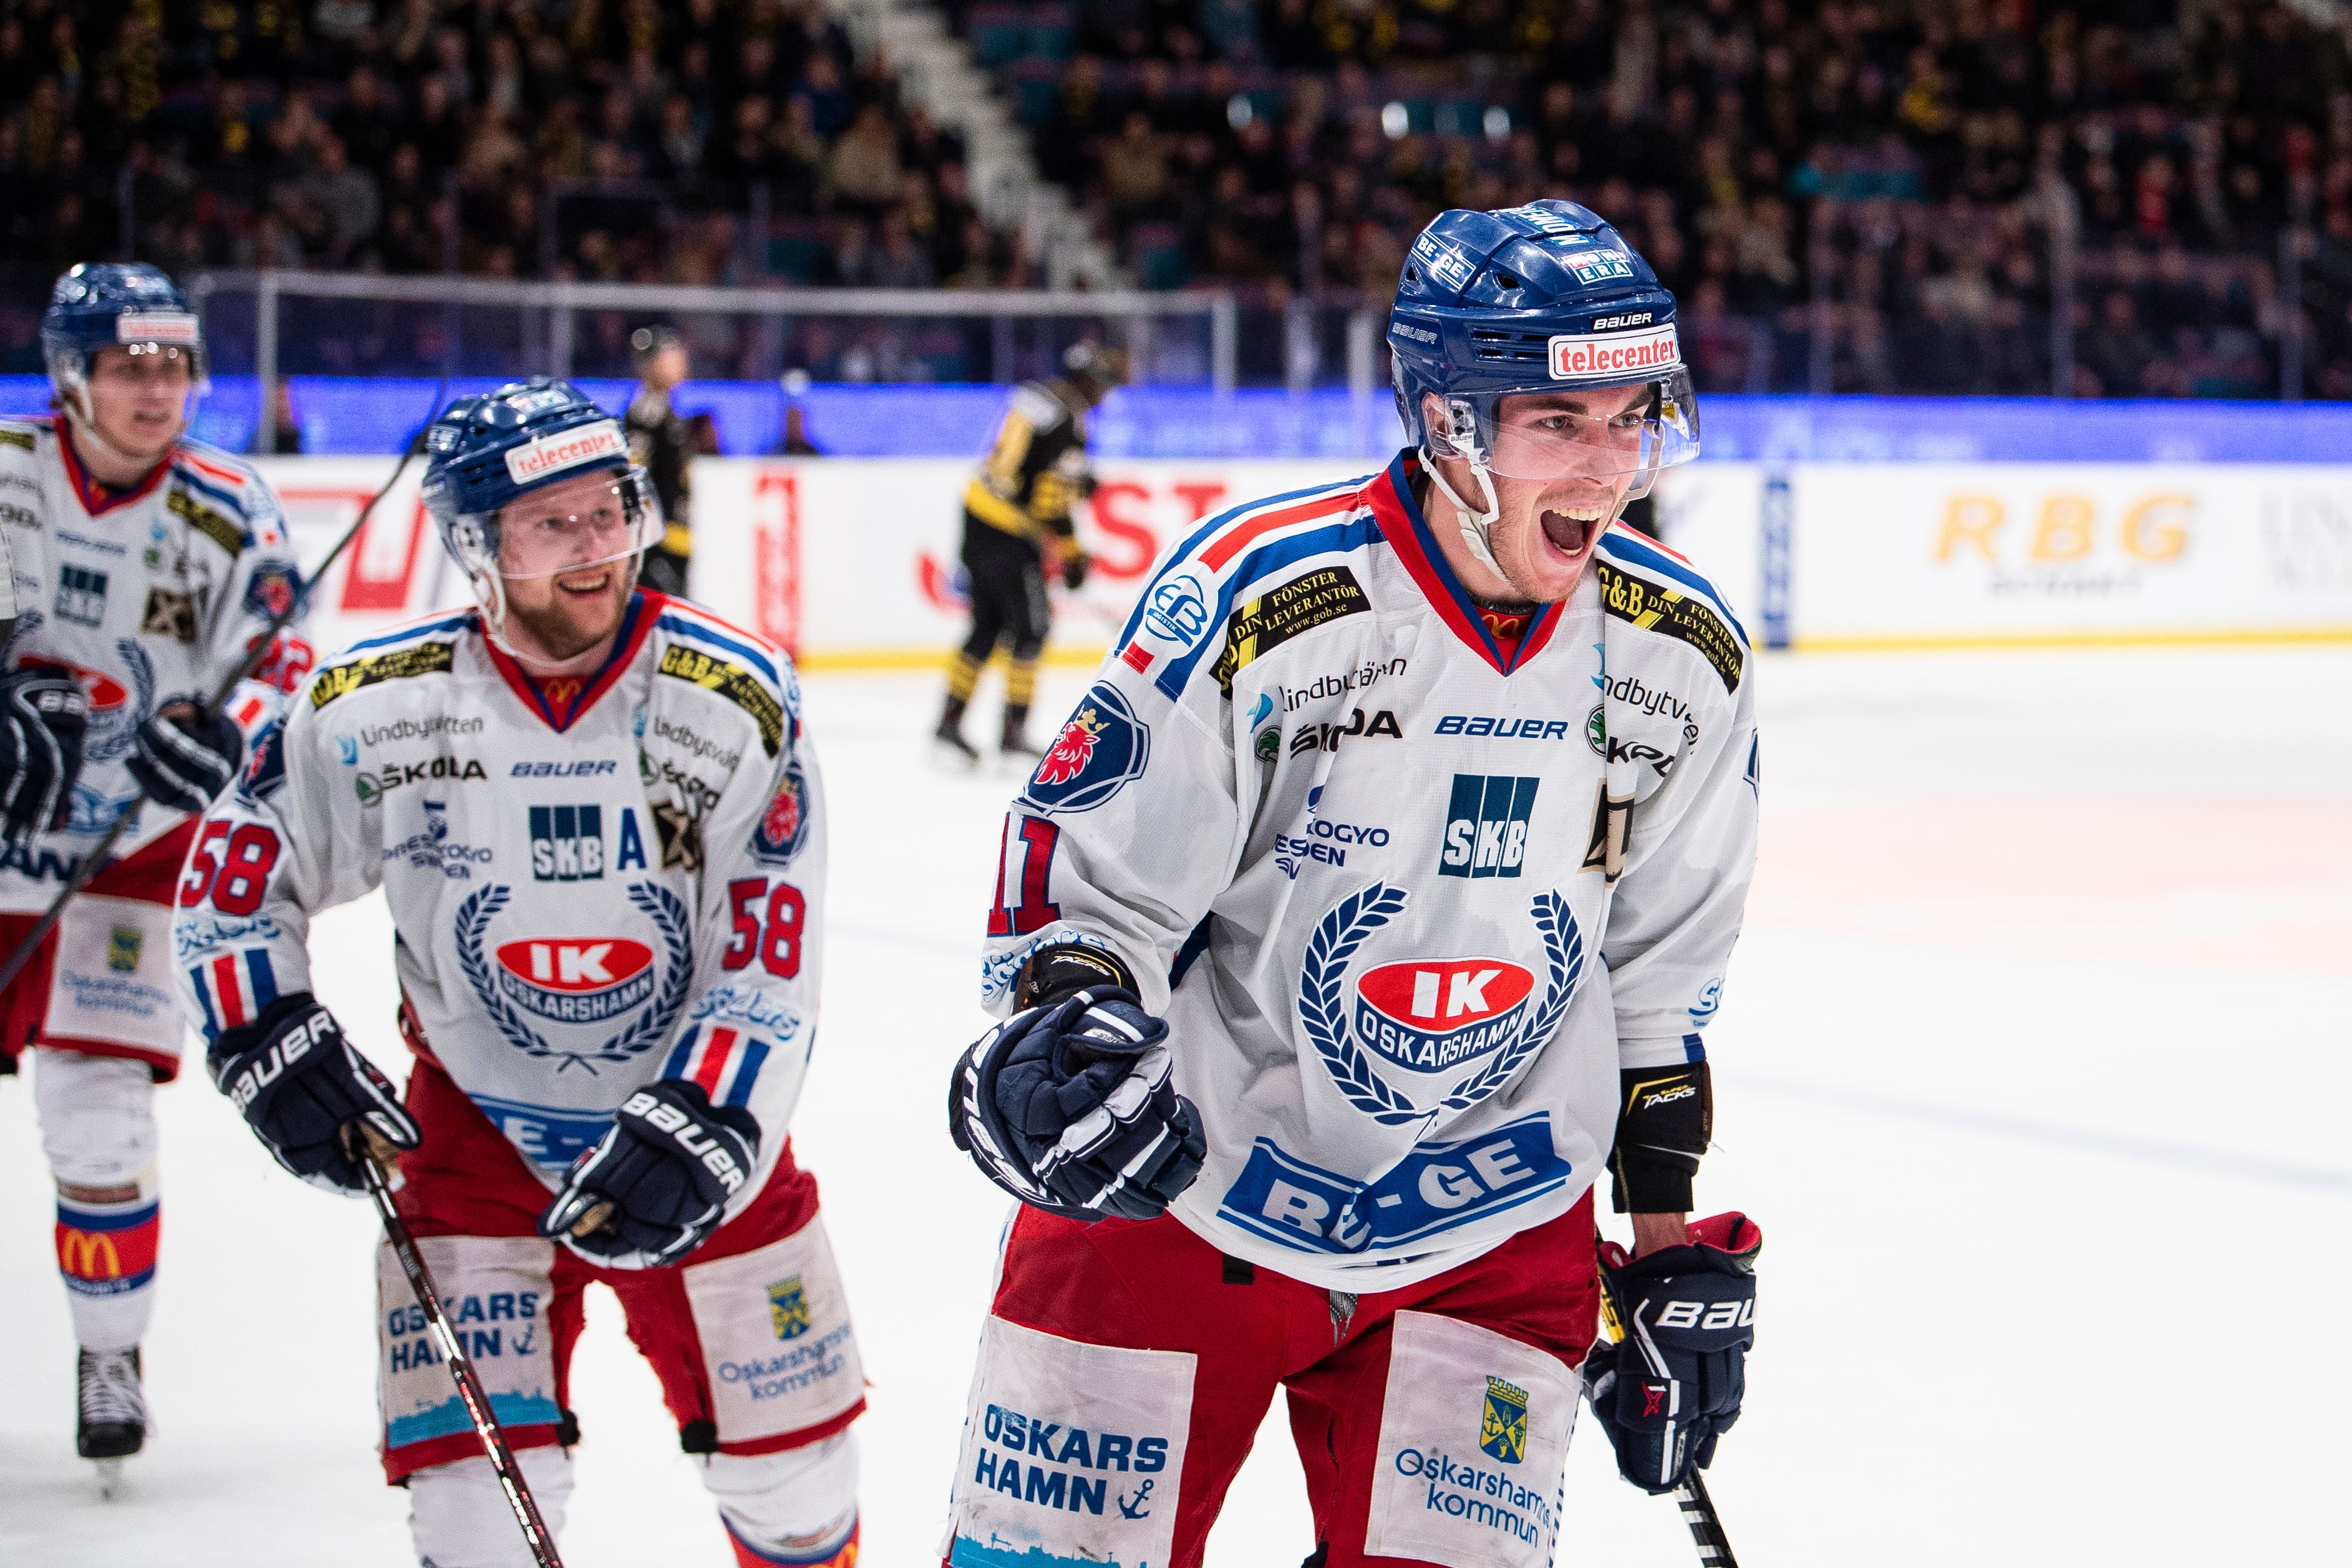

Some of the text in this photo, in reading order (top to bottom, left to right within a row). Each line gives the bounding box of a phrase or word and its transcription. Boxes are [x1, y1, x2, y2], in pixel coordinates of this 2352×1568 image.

[1416, 235, 1465, 278] BE-GE
[1579, 263, 1628, 280] ERA
[1391, 322, 1437, 344] BAUER
[1593, 312, 1652, 330] BAUER
[1561, 337, 1675, 372] telecenter
[519, 432, 617, 474] telecenter
[1234, 614, 1263, 640] DIN
[1265, 584, 1360, 631] LEVERANTÖR
[1271, 571, 1338, 607] FÖNSTER
[1648, 596, 1675, 614] DIN
[1285, 604, 1347, 634] www.gob.se
[1691, 604, 1735, 652] FÖNSTER
[1673, 612, 1740, 680] LEVERANTÖR
[1435, 715, 1569, 740] BAUER
[510, 760, 617, 777] BAUER
[533, 835, 603, 876] SKB
[617, 806, 647, 871] A
[1443, 818, 1528, 868] SKB
[181, 819, 281, 917] 58
[722, 876, 806, 980] 58
[530, 942, 614, 984] IK
[501, 971, 653, 1020] OSKARSHAMN
[1411, 969, 1503, 1019] IK
[1362, 1008, 1524, 1067] OSKARSHAMN
[1642, 1086, 1696, 1109] TACKS
[621, 1092, 745, 1195] BAUER
[389, 1291, 540, 1337] OSARS
[984, 1403, 1168, 1473] OSKARS
[975, 1447, 1108, 1516] HAMN
[1426, 1483, 1539, 1549] kommun
